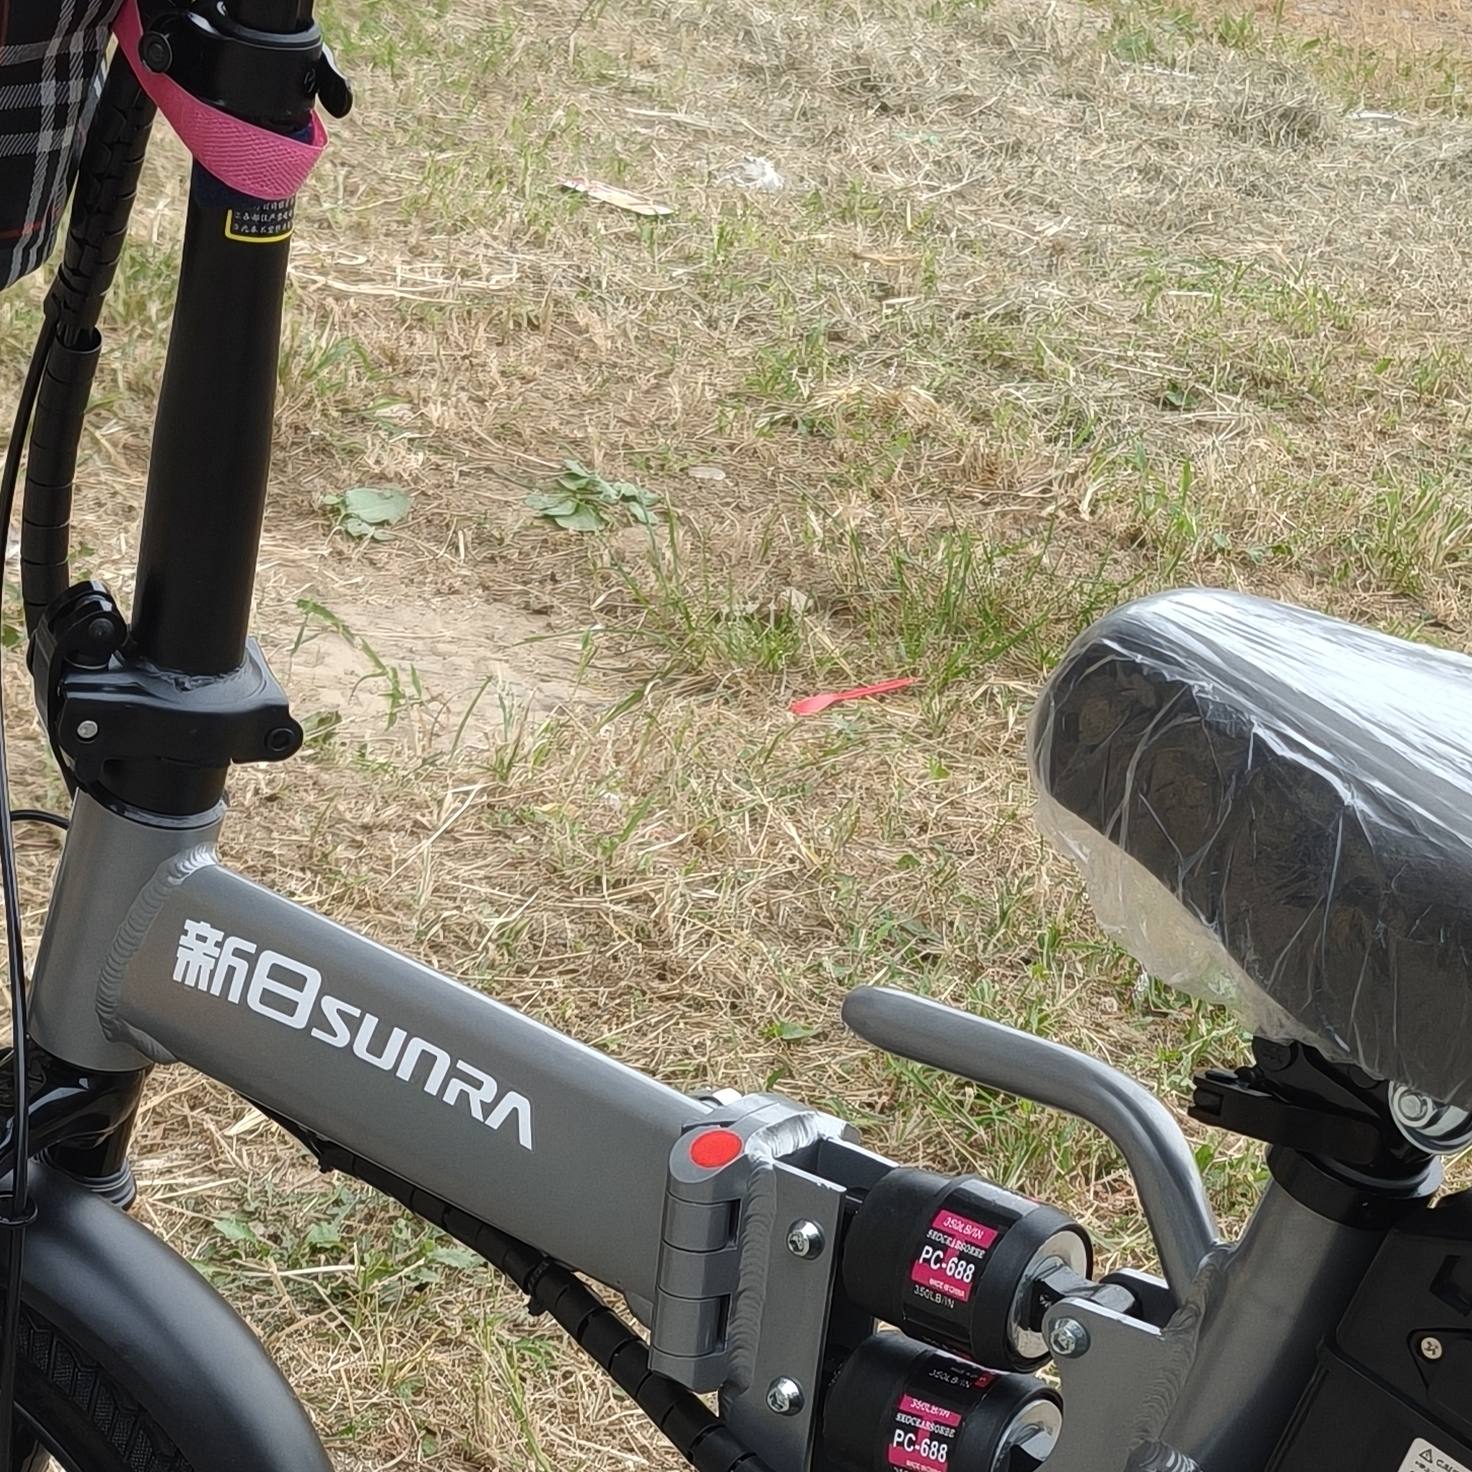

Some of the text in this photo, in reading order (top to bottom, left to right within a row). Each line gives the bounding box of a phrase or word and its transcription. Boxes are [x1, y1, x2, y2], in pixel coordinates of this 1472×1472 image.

[173, 919, 534, 1152] 新日 SUNRA
[919, 1245, 975, 1283] PC-688
[893, 1428, 948, 1463] PC-688
